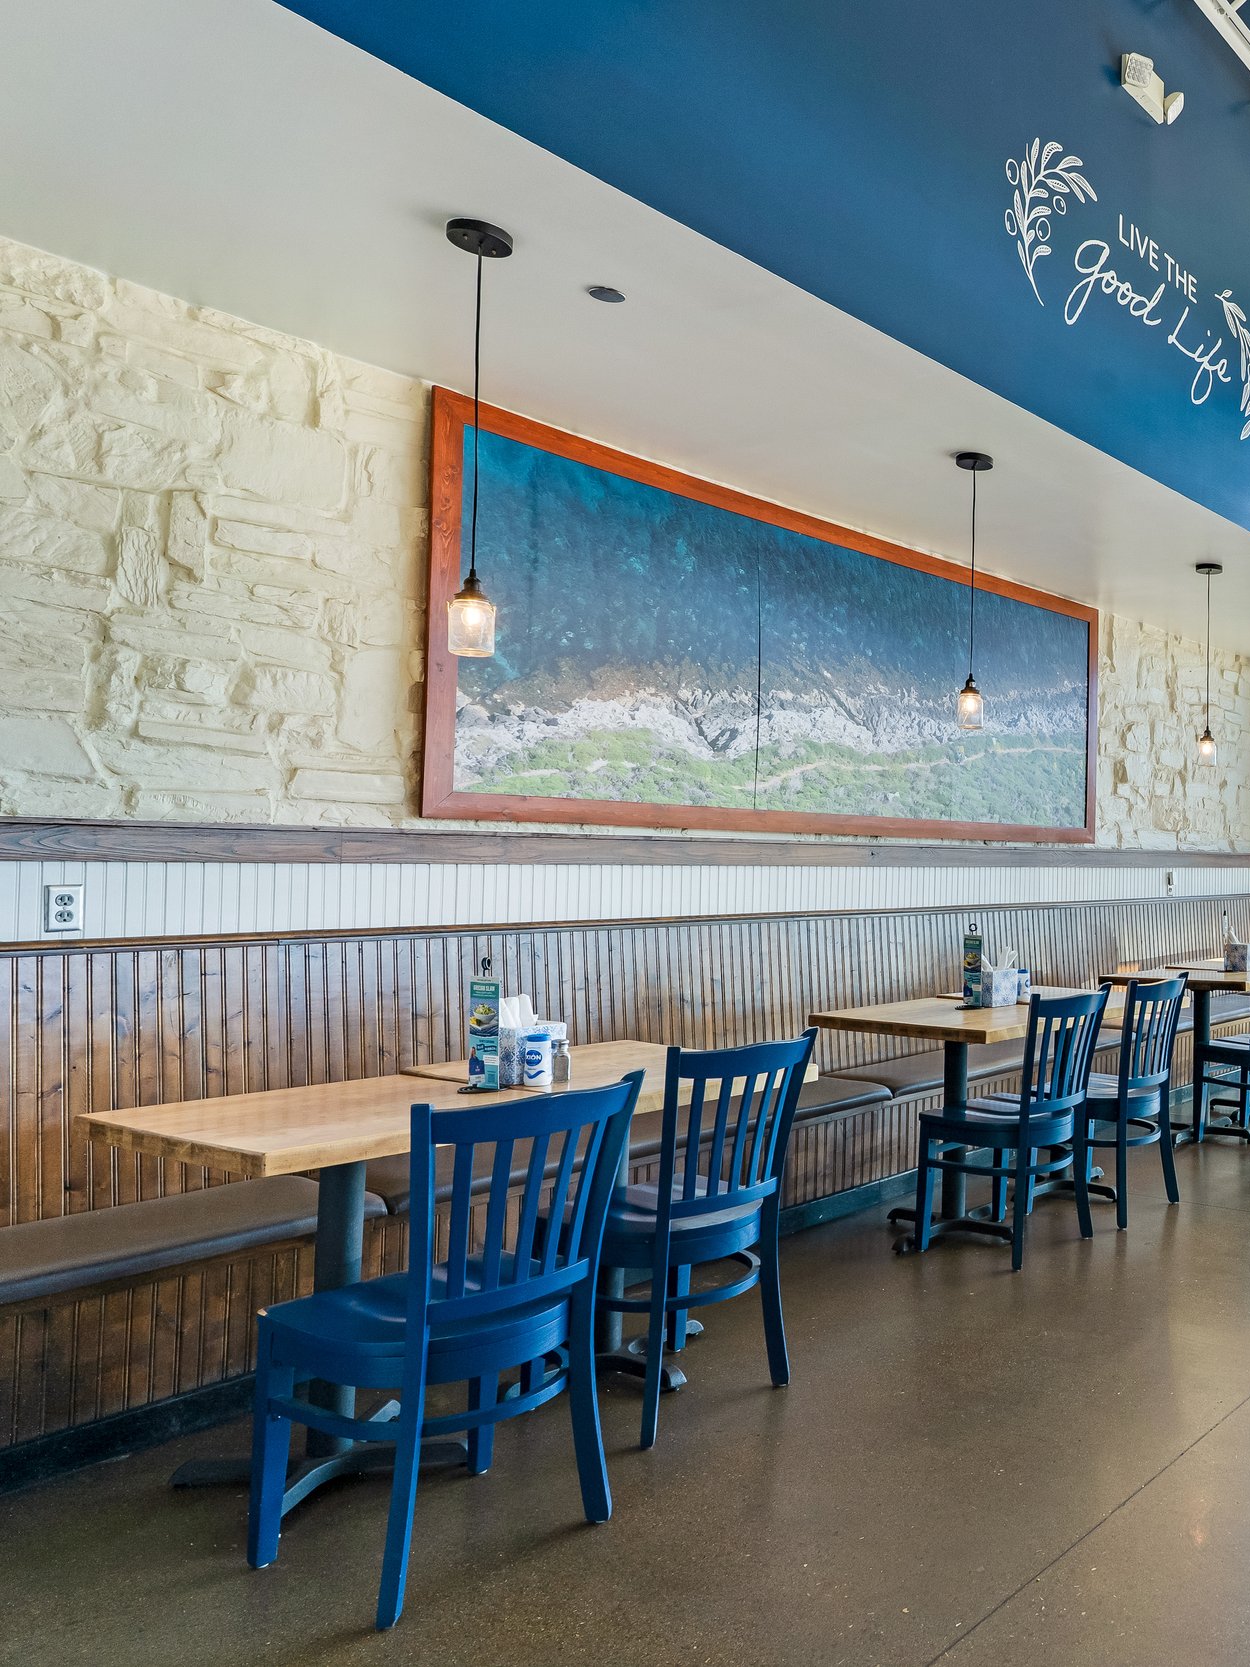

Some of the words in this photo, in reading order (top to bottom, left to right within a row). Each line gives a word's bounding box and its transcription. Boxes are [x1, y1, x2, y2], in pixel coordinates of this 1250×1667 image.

[1118, 213, 1159, 271] LIVE
[1163, 252, 1198, 303] THE
[1064, 240, 1166, 326] good
[1167, 306, 1231, 404] Life
